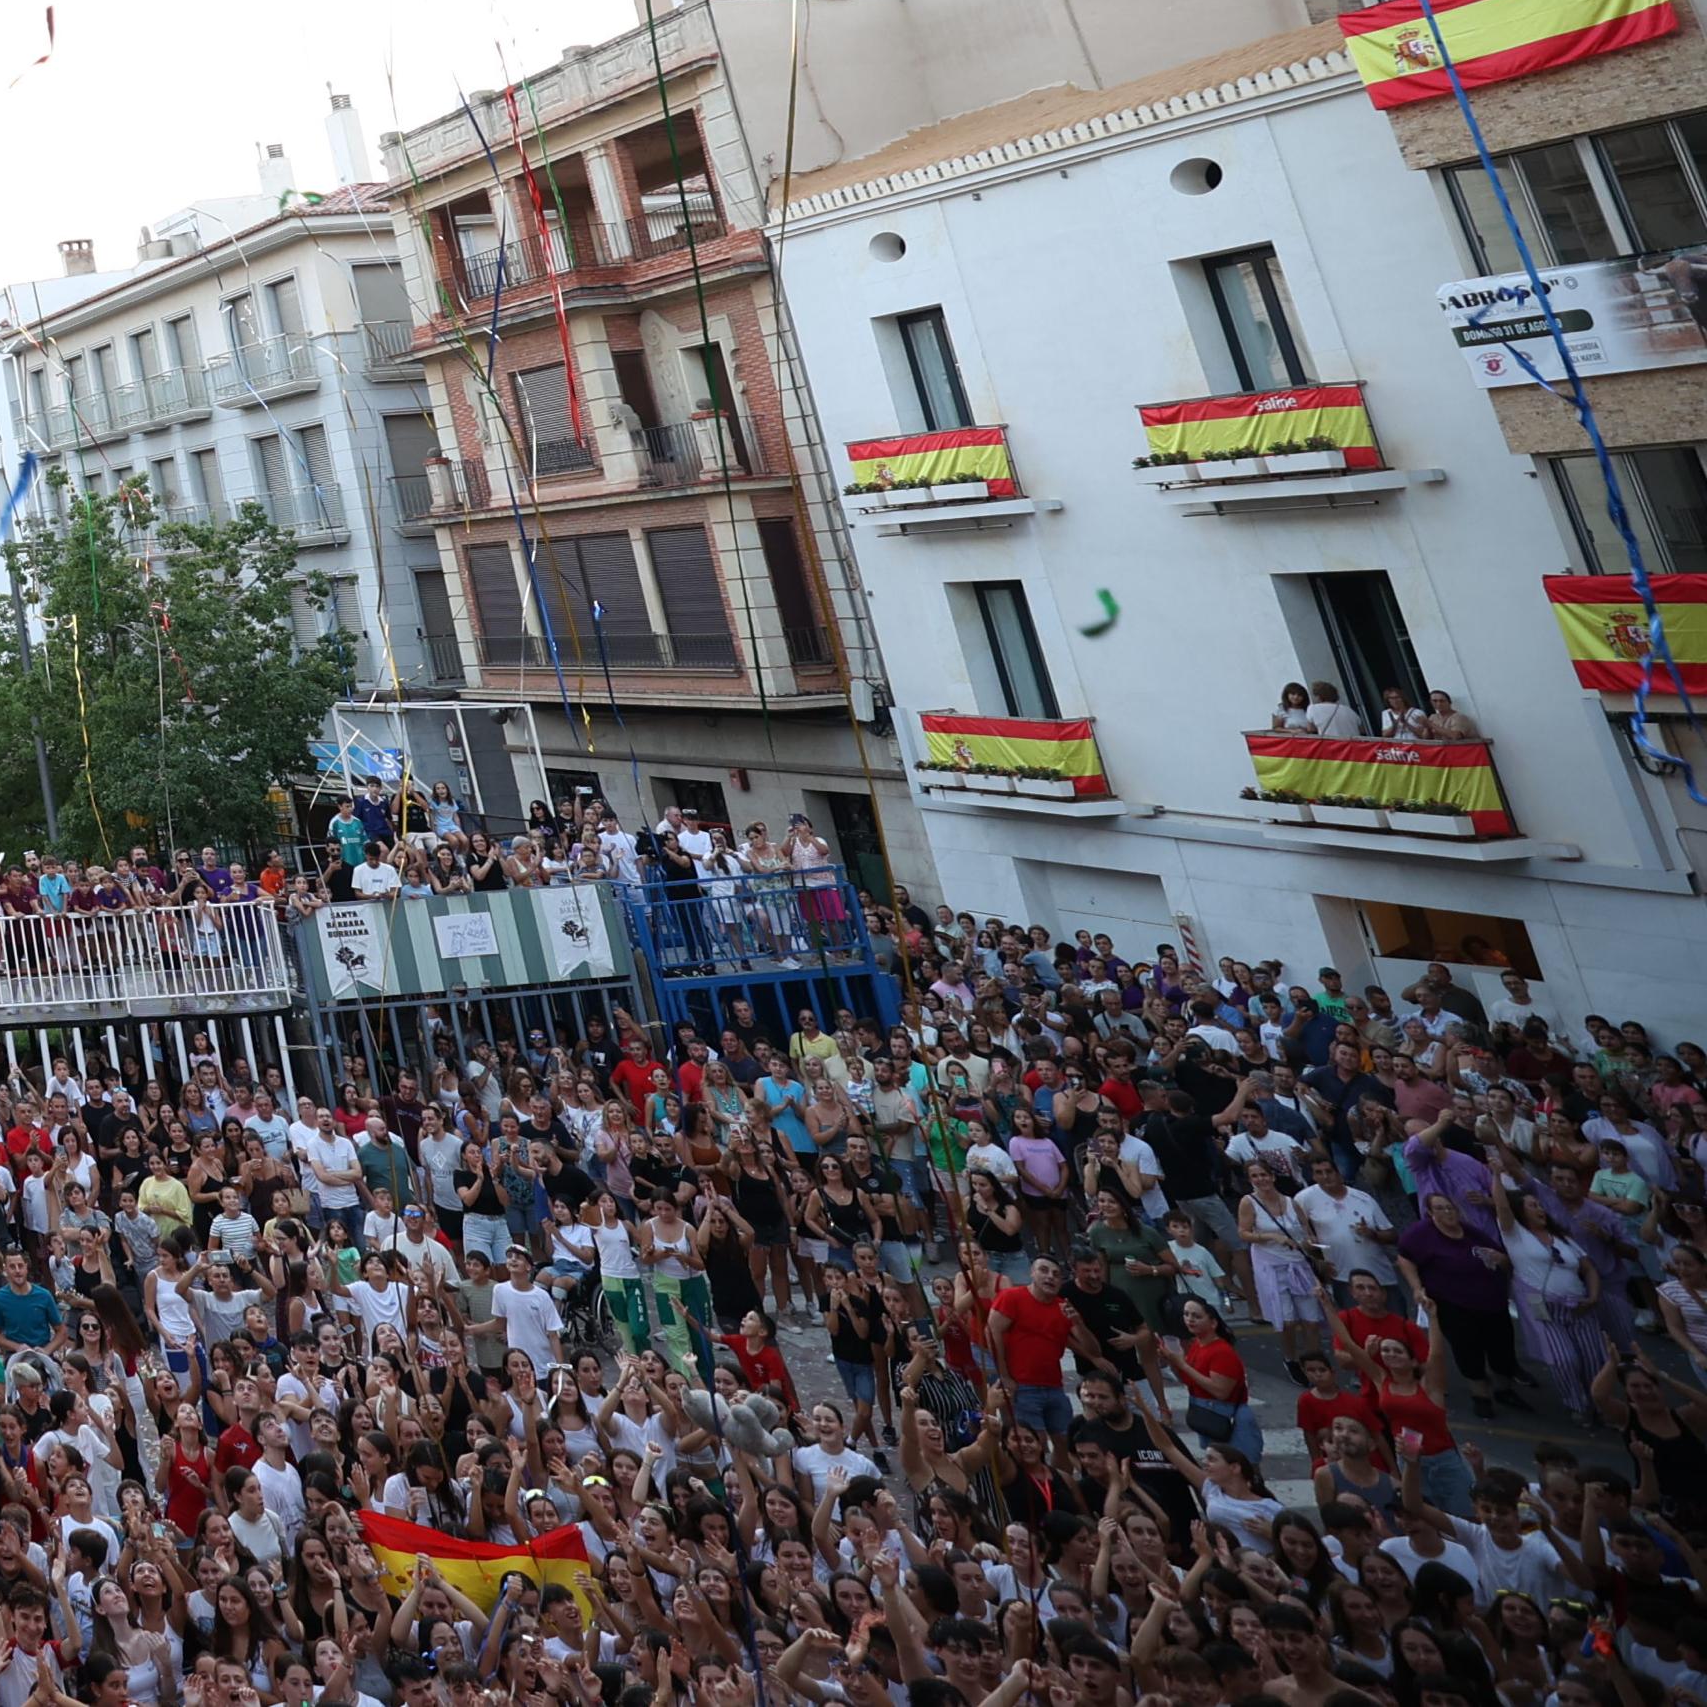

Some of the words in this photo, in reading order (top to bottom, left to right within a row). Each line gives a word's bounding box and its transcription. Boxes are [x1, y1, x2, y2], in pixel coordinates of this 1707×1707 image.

[1503, 325, 1514, 335] 31
[1514, 323, 1528, 334] DE
[1528, 318, 1563, 332] AGOSO
